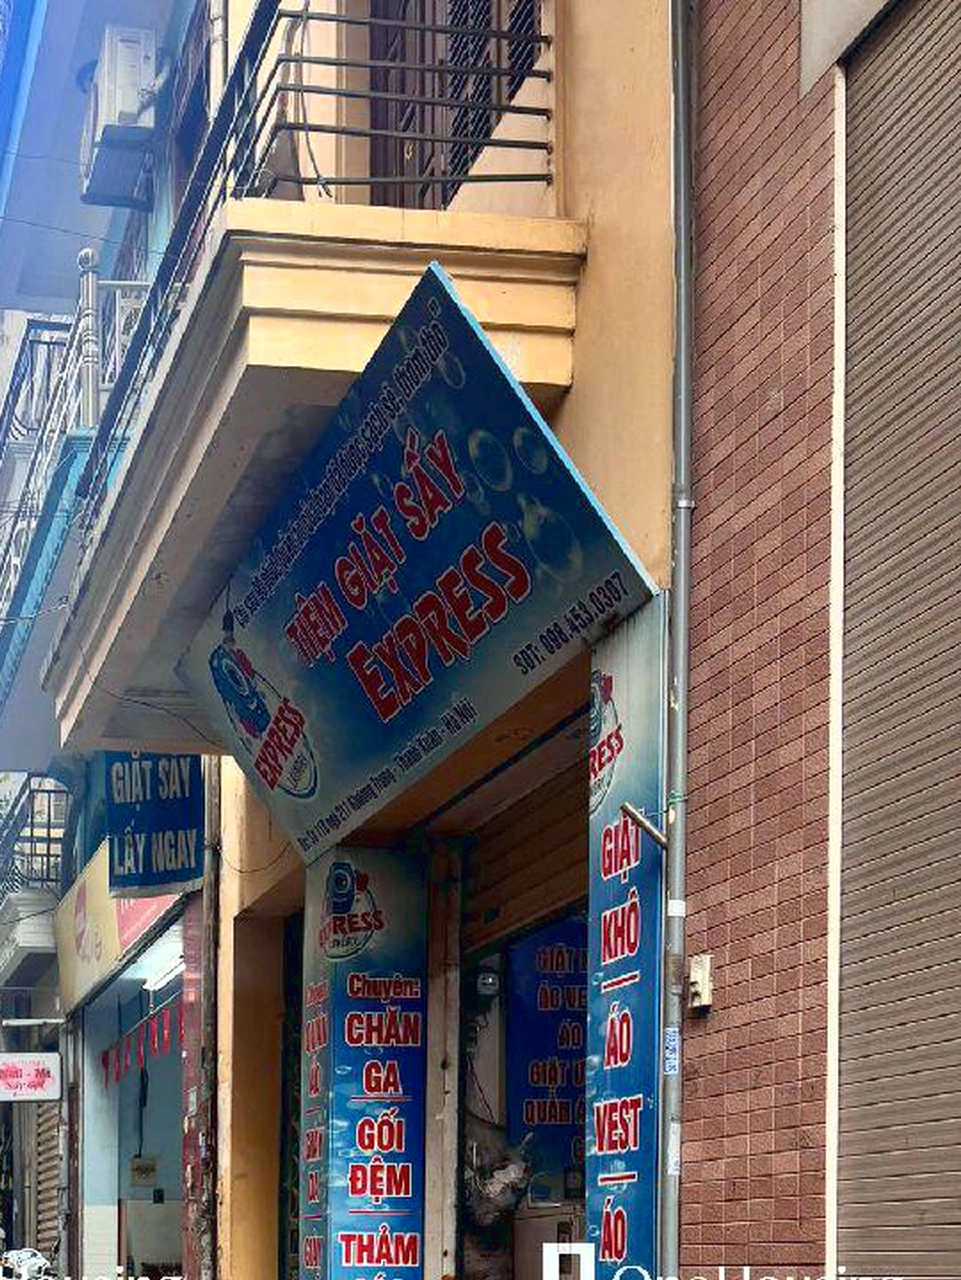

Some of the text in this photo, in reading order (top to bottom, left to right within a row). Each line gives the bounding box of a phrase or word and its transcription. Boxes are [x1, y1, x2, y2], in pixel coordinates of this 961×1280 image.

[335, 506, 407, 611] GIẶT
[394, 427, 465, 540] SẤY
[345, 521, 533, 723] EXPRESS
[253, 698, 306, 791] EXPRESS
[113, 819, 198, 876] LẤY NGAY
[600, 888, 641, 965] KHÔ
[347, 971, 421, 1002] Chuyên:
[345, 1006, 421, 1049] CHĂN
[604, 1000, 633, 1071] ÁO
[362, 1059, 404, 1096] GA
[356, 1106, 405, 1154] GỐI
[594, 1096, 643, 1154] VEST
[348, 1157, 413, 1205] ĐỆM
[338, 1222, 420, 1267] THẢM
[599, 1198, 628, 1263] ÁO
